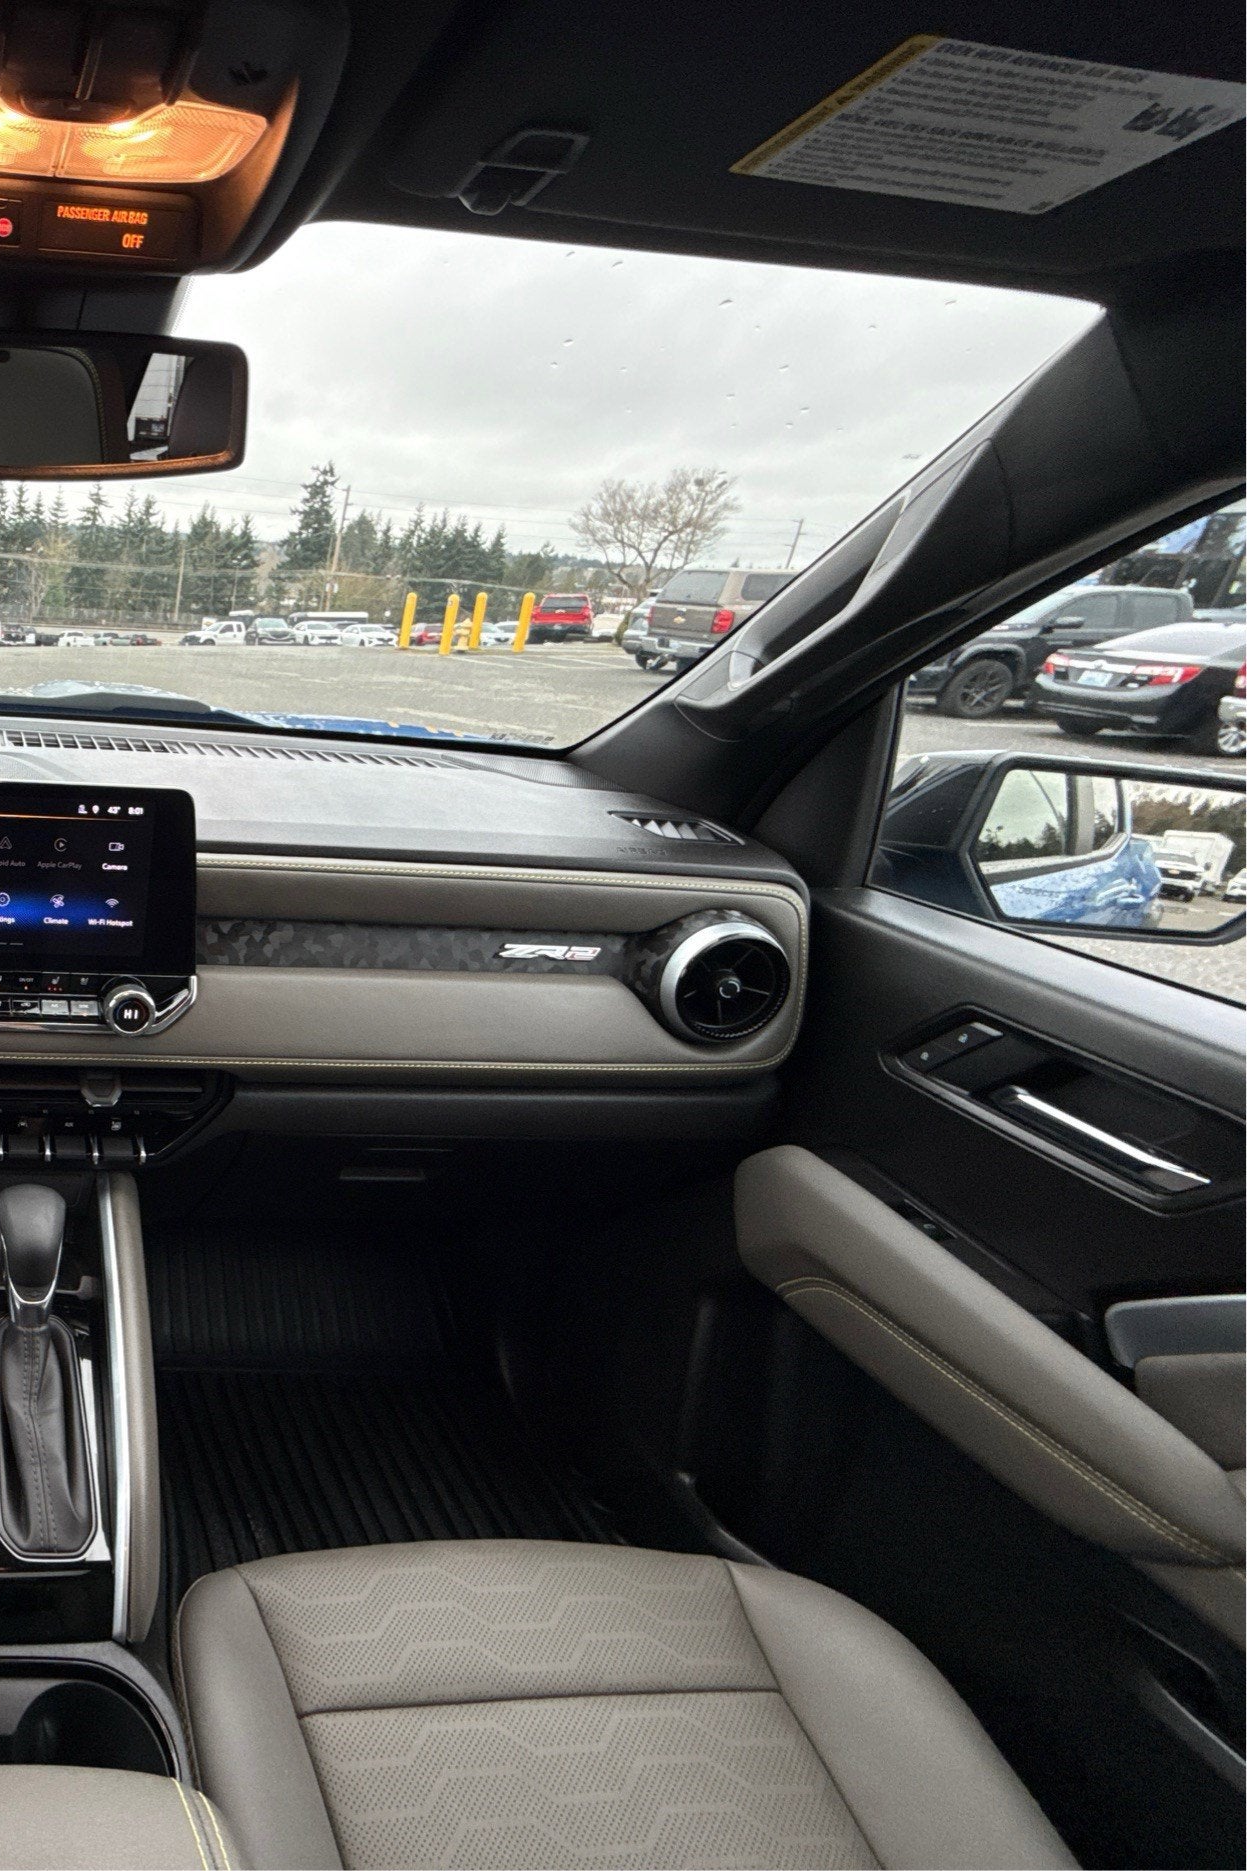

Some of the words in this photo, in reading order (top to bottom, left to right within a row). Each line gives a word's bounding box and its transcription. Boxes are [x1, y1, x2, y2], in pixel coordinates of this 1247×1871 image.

[56, 205, 111, 222] PASSENGER
[121, 232, 145, 249] OFF
[10, 860, 26, 868] Auto
[37, 860, 56, 870] Apple
[57, 861, 83, 871] CarPlay
[102, 863, 129, 872] Camera
[43, 917, 69, 925] Climate
[498, 943, 602, 961] ZR2
[123, 1009, 139, 1020] HI
